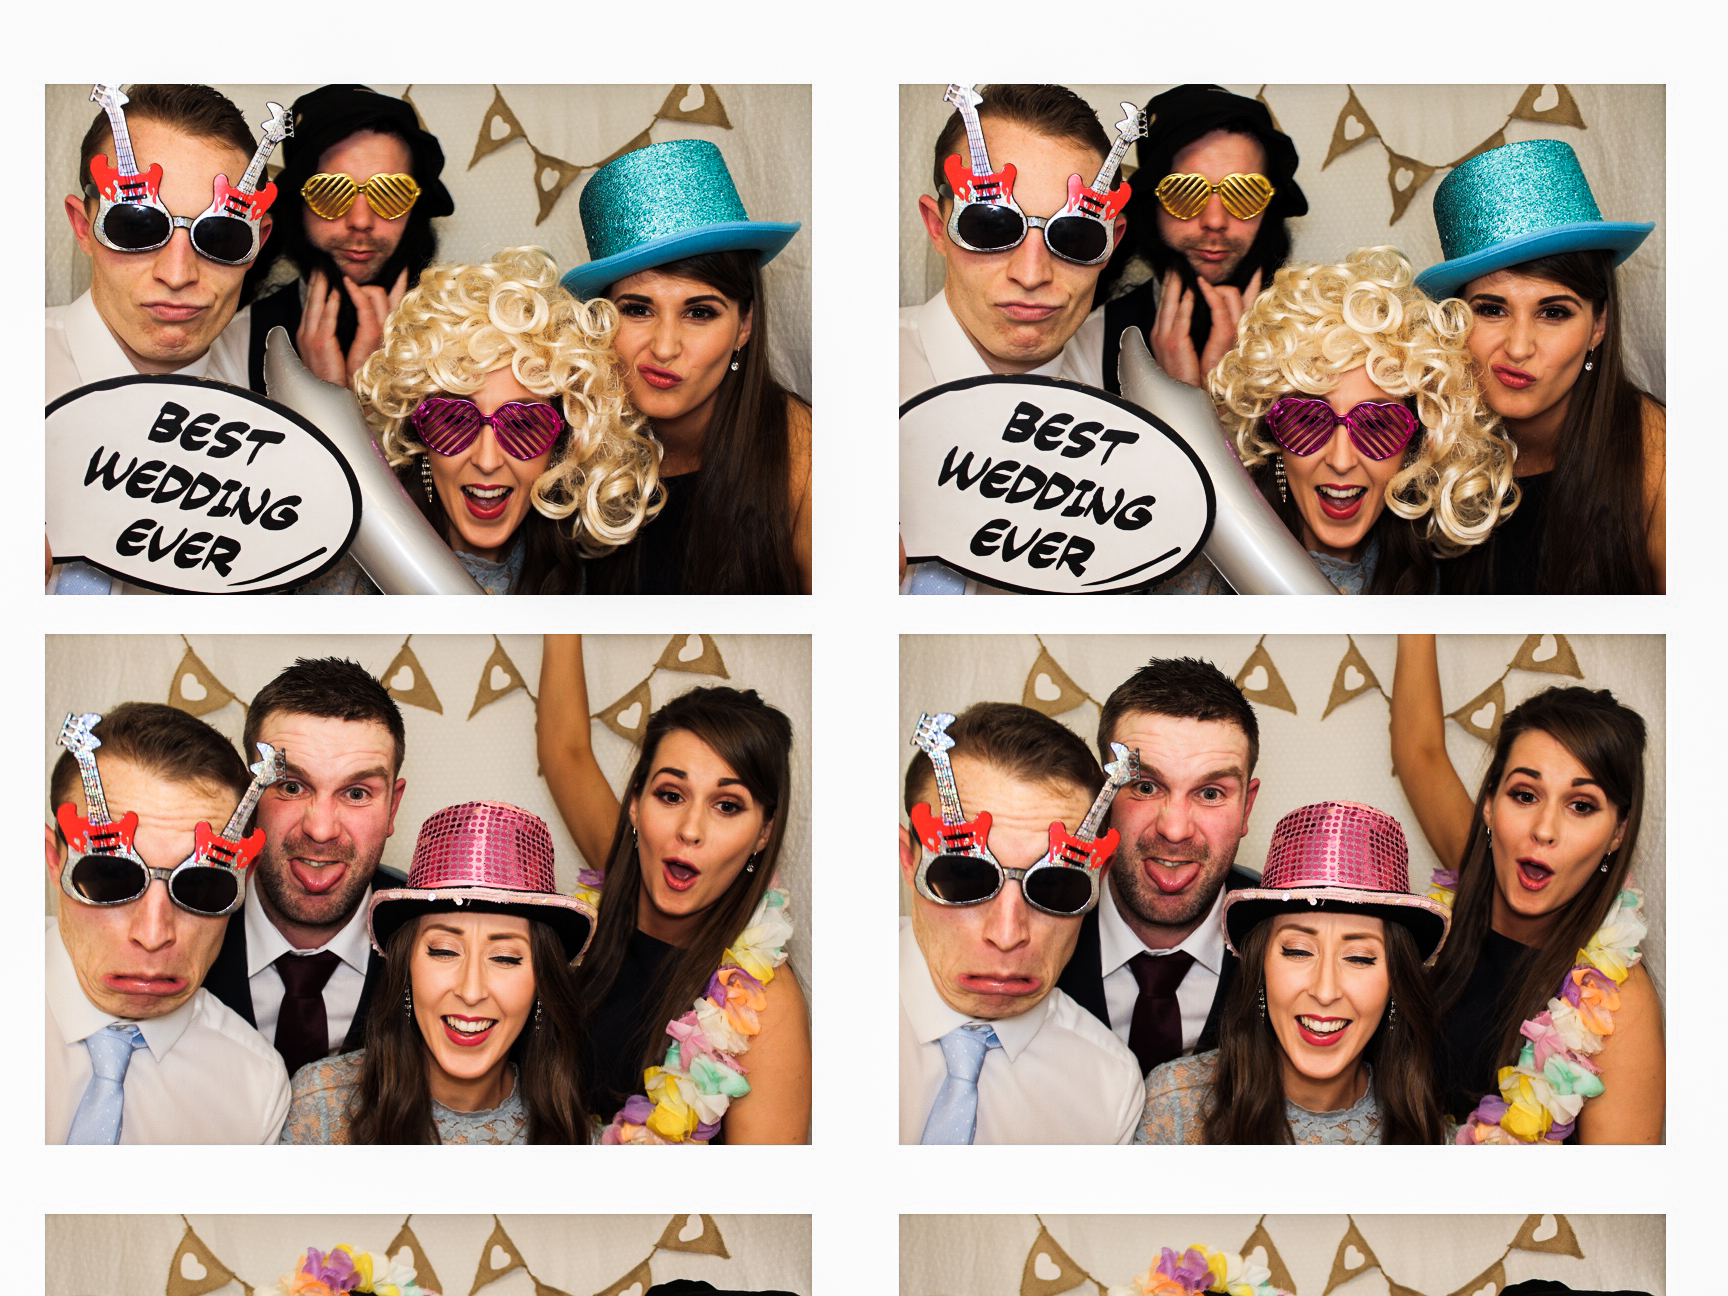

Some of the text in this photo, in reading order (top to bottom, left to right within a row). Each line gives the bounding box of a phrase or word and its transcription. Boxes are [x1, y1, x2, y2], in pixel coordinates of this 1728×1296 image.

[147, 401, 286, 466] BEST
[1001, 401, 1140, 466] BEST
[83, 445, 303, 531] WEDDING
[937, 445, 1157, 531] WEDDING
[115, 518, 242, 578] EVER
[969, 518, 1096, 578] EVER
